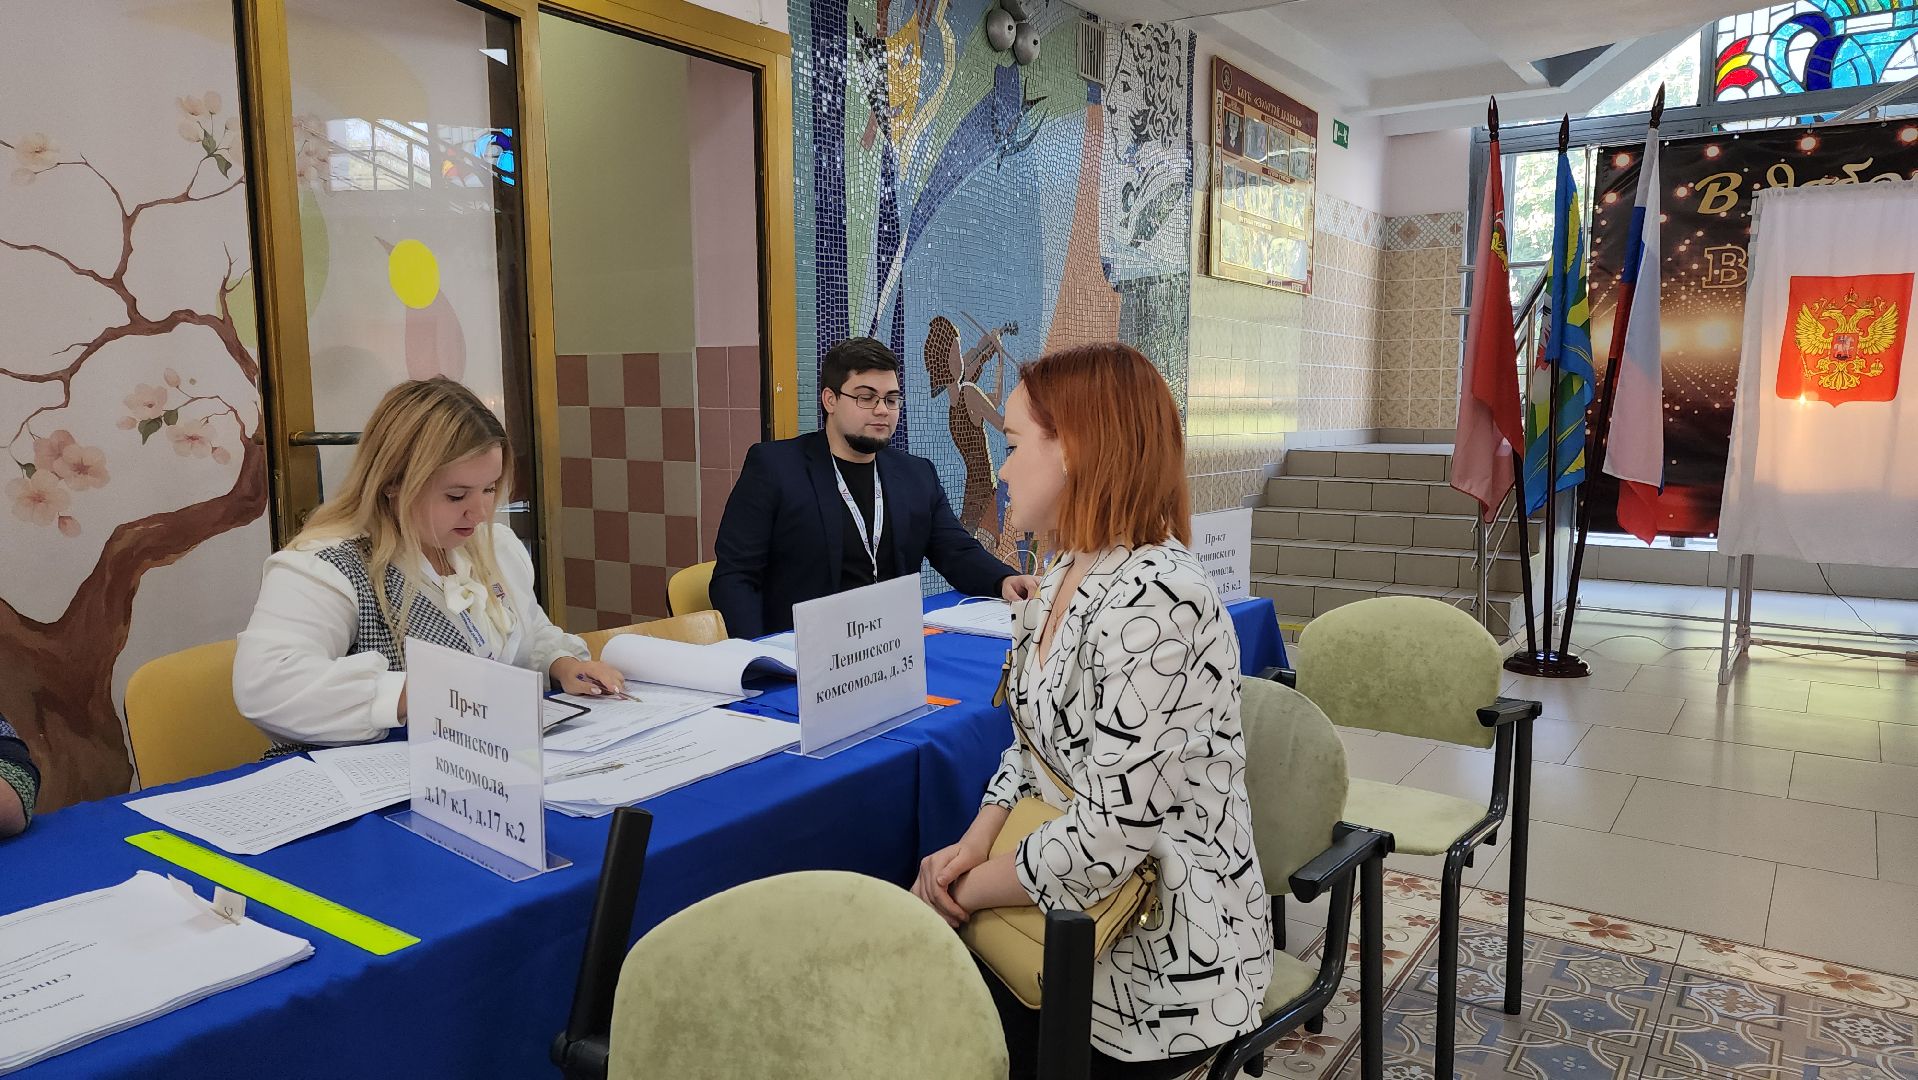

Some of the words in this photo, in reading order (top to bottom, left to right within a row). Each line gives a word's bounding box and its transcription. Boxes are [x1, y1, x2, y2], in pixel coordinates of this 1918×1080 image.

[1205, 533, 1226, 546] Пр-кт
[846, 617, 883, 639] Пр-кт
[829, 637, 901, 671] Ленинского
[816, 669, 888, 703] комсомола,
[889, 665, 900, 679] д.
[902, 655, 914, 673] 35
[449, 688, 489, 720] Пр-кт
[432, 717, 509, 763] Ленинского
[435, 756, 509, 802] комсомола,
[424, 786, 448, 806] д.17
[451, 798, 473, 824] к.1,
[476, 808, 501, 832] д.17
[506, 822, 526, 843] к.2
[0, 973, 72, 1003] СПИСО
